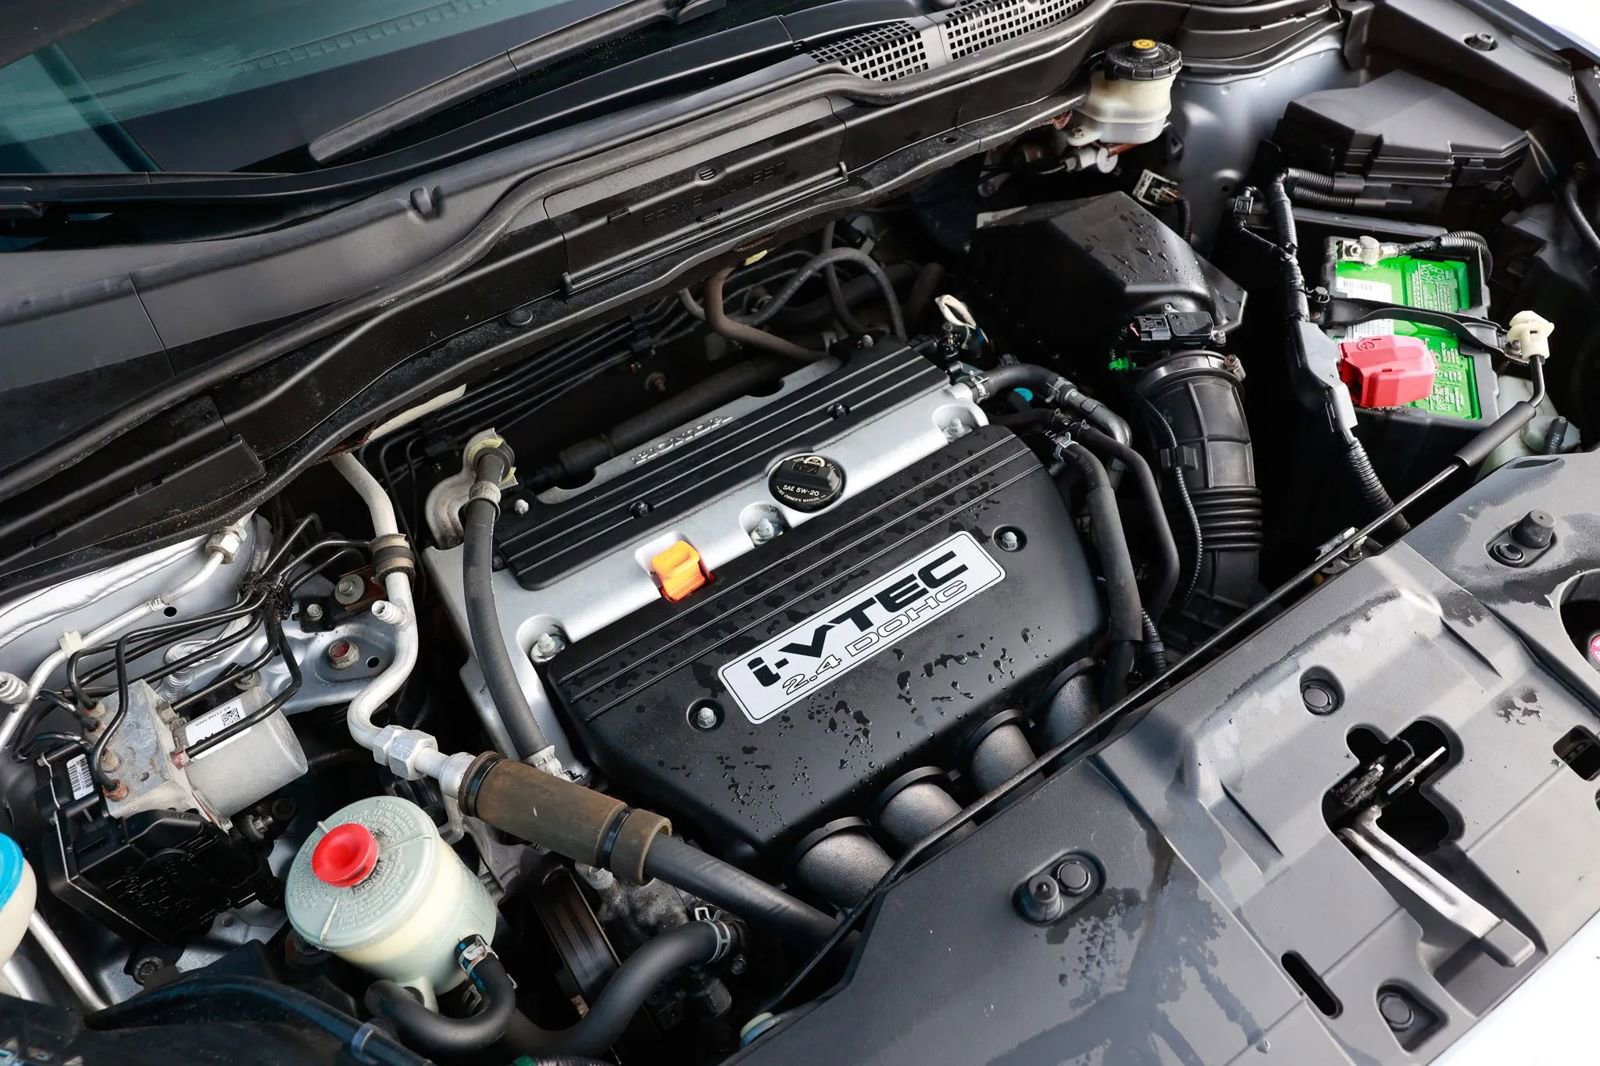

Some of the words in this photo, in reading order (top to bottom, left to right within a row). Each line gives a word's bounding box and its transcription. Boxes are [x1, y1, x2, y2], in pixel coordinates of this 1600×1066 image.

[631, 415, 733, 466] HONDA
[782, 484, 795, 492] SAE
[746, 550, 969, 688] i-VTEC
[781, 653, 843, 696] 2.4
[844, 579, 968, 657] DOHC
